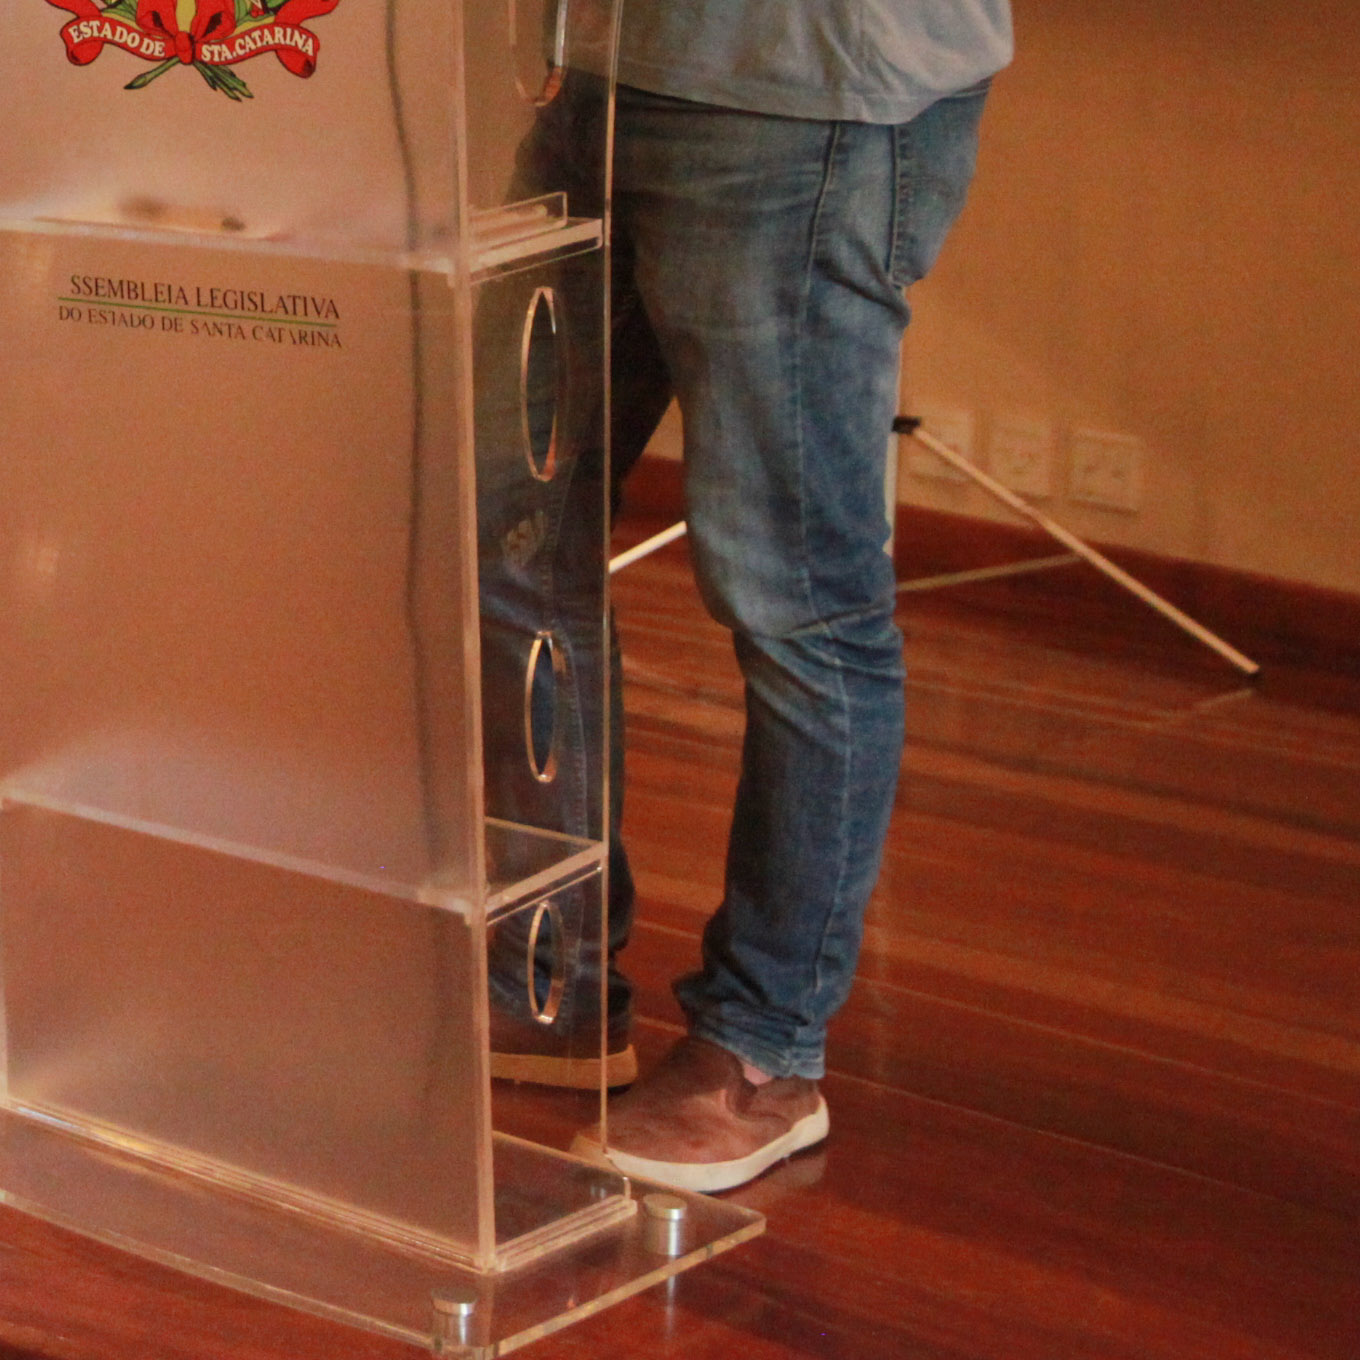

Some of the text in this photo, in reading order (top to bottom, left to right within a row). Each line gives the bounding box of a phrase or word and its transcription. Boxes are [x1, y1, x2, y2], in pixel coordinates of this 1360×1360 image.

[68, 20, 140, 48] ESTADO
[140, 37, 166, 57] DE
[195, 286, 340, 320] LEGISLATIVA
[58, 305, 343, 349] DO ESTADO DE SANTA CATARINA
